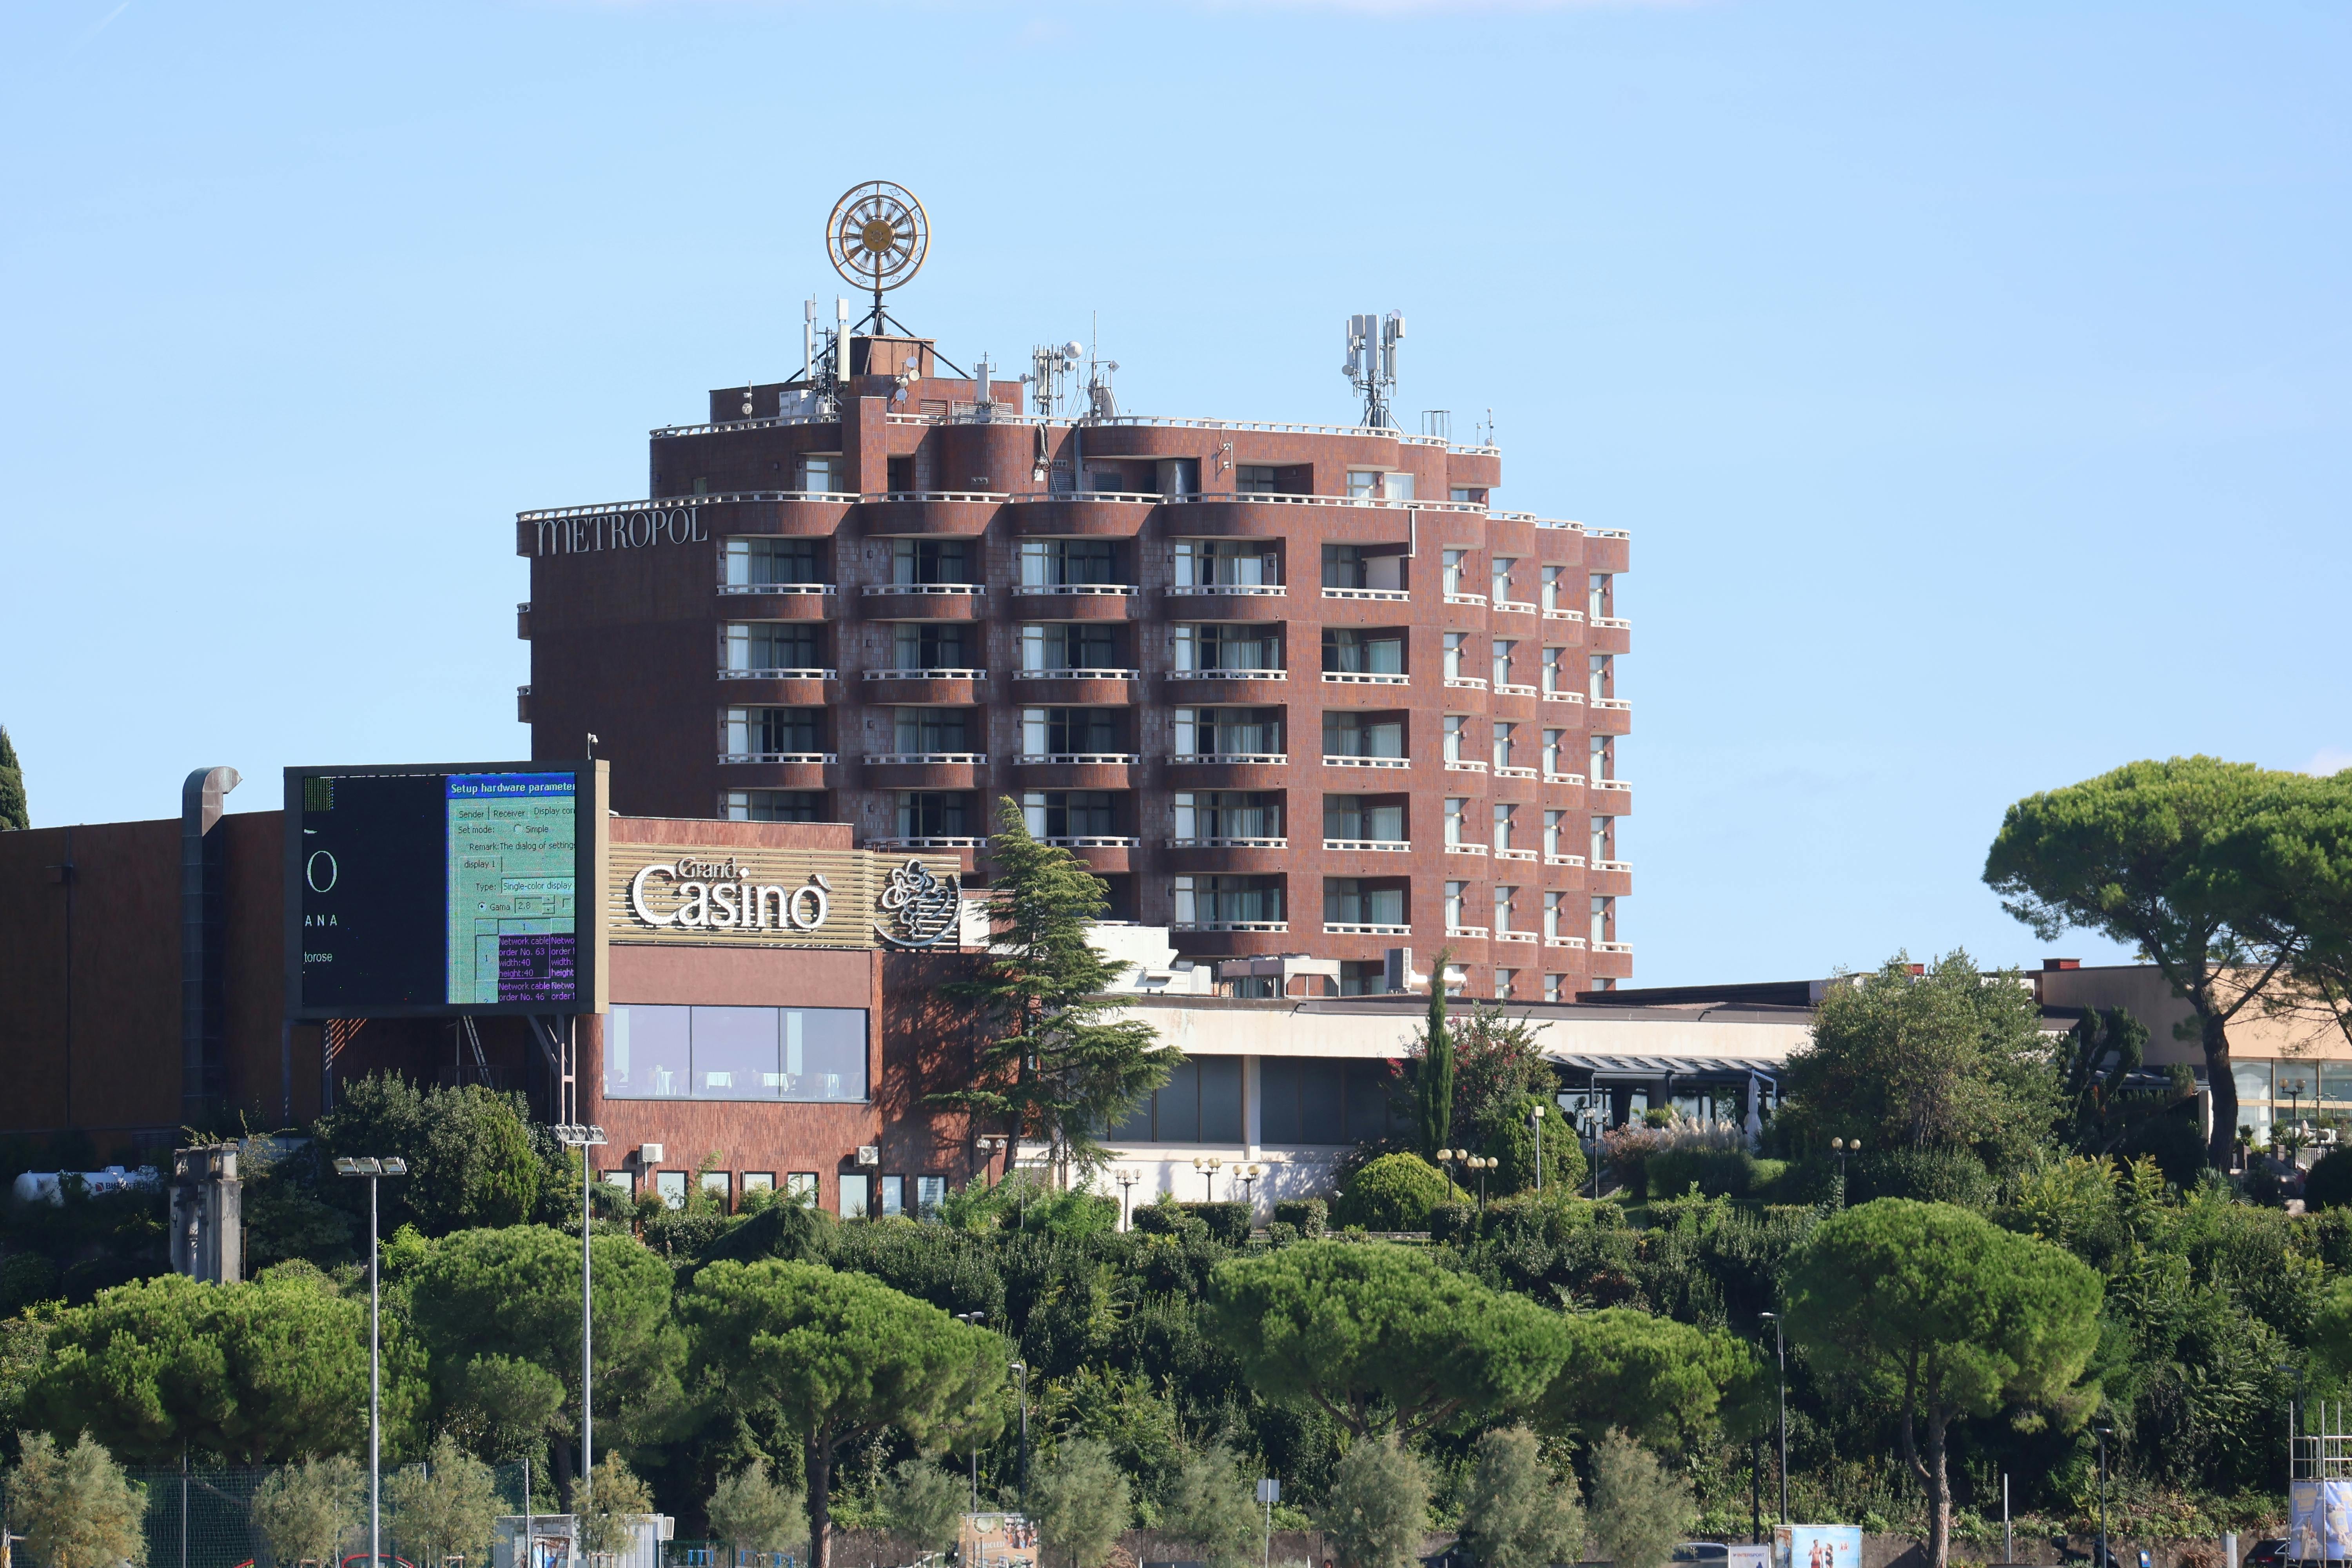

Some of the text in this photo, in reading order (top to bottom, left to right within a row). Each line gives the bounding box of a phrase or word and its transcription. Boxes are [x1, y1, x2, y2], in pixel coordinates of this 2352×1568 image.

[535, 507, 708, 557] METROPOL
[452, 784, 478, 795] Setup
[481, 783, 525, 792] hardware
[459, 810, 484, 818] Sender
[494, 809, 525, 817] Receiver
[534, 806, 560, 816] Display
[472, 825, 495, 833] mode:
[526, 825, 549, 834] Simple
[515, 842, 536, 851] dialog
[464, 860, 489, 869] display
[677, 857, 738, 879] Grand
[307, 851, 337, 892] O
[476, 883, 496, 892] Type:
[503, 881, 572, 891] Single-color display
[632, 863, 833, 929] Casinò
[499, 937, 529, 945] Network
[551, 946, 571, 955] order
[304, 951, 332, 962] torose
[551, 957, 573, 965] width:
[499, 969, 534, 978] height:40
[552, 968, 574, 978] height
[499, 981, 550, 991] Network cable
